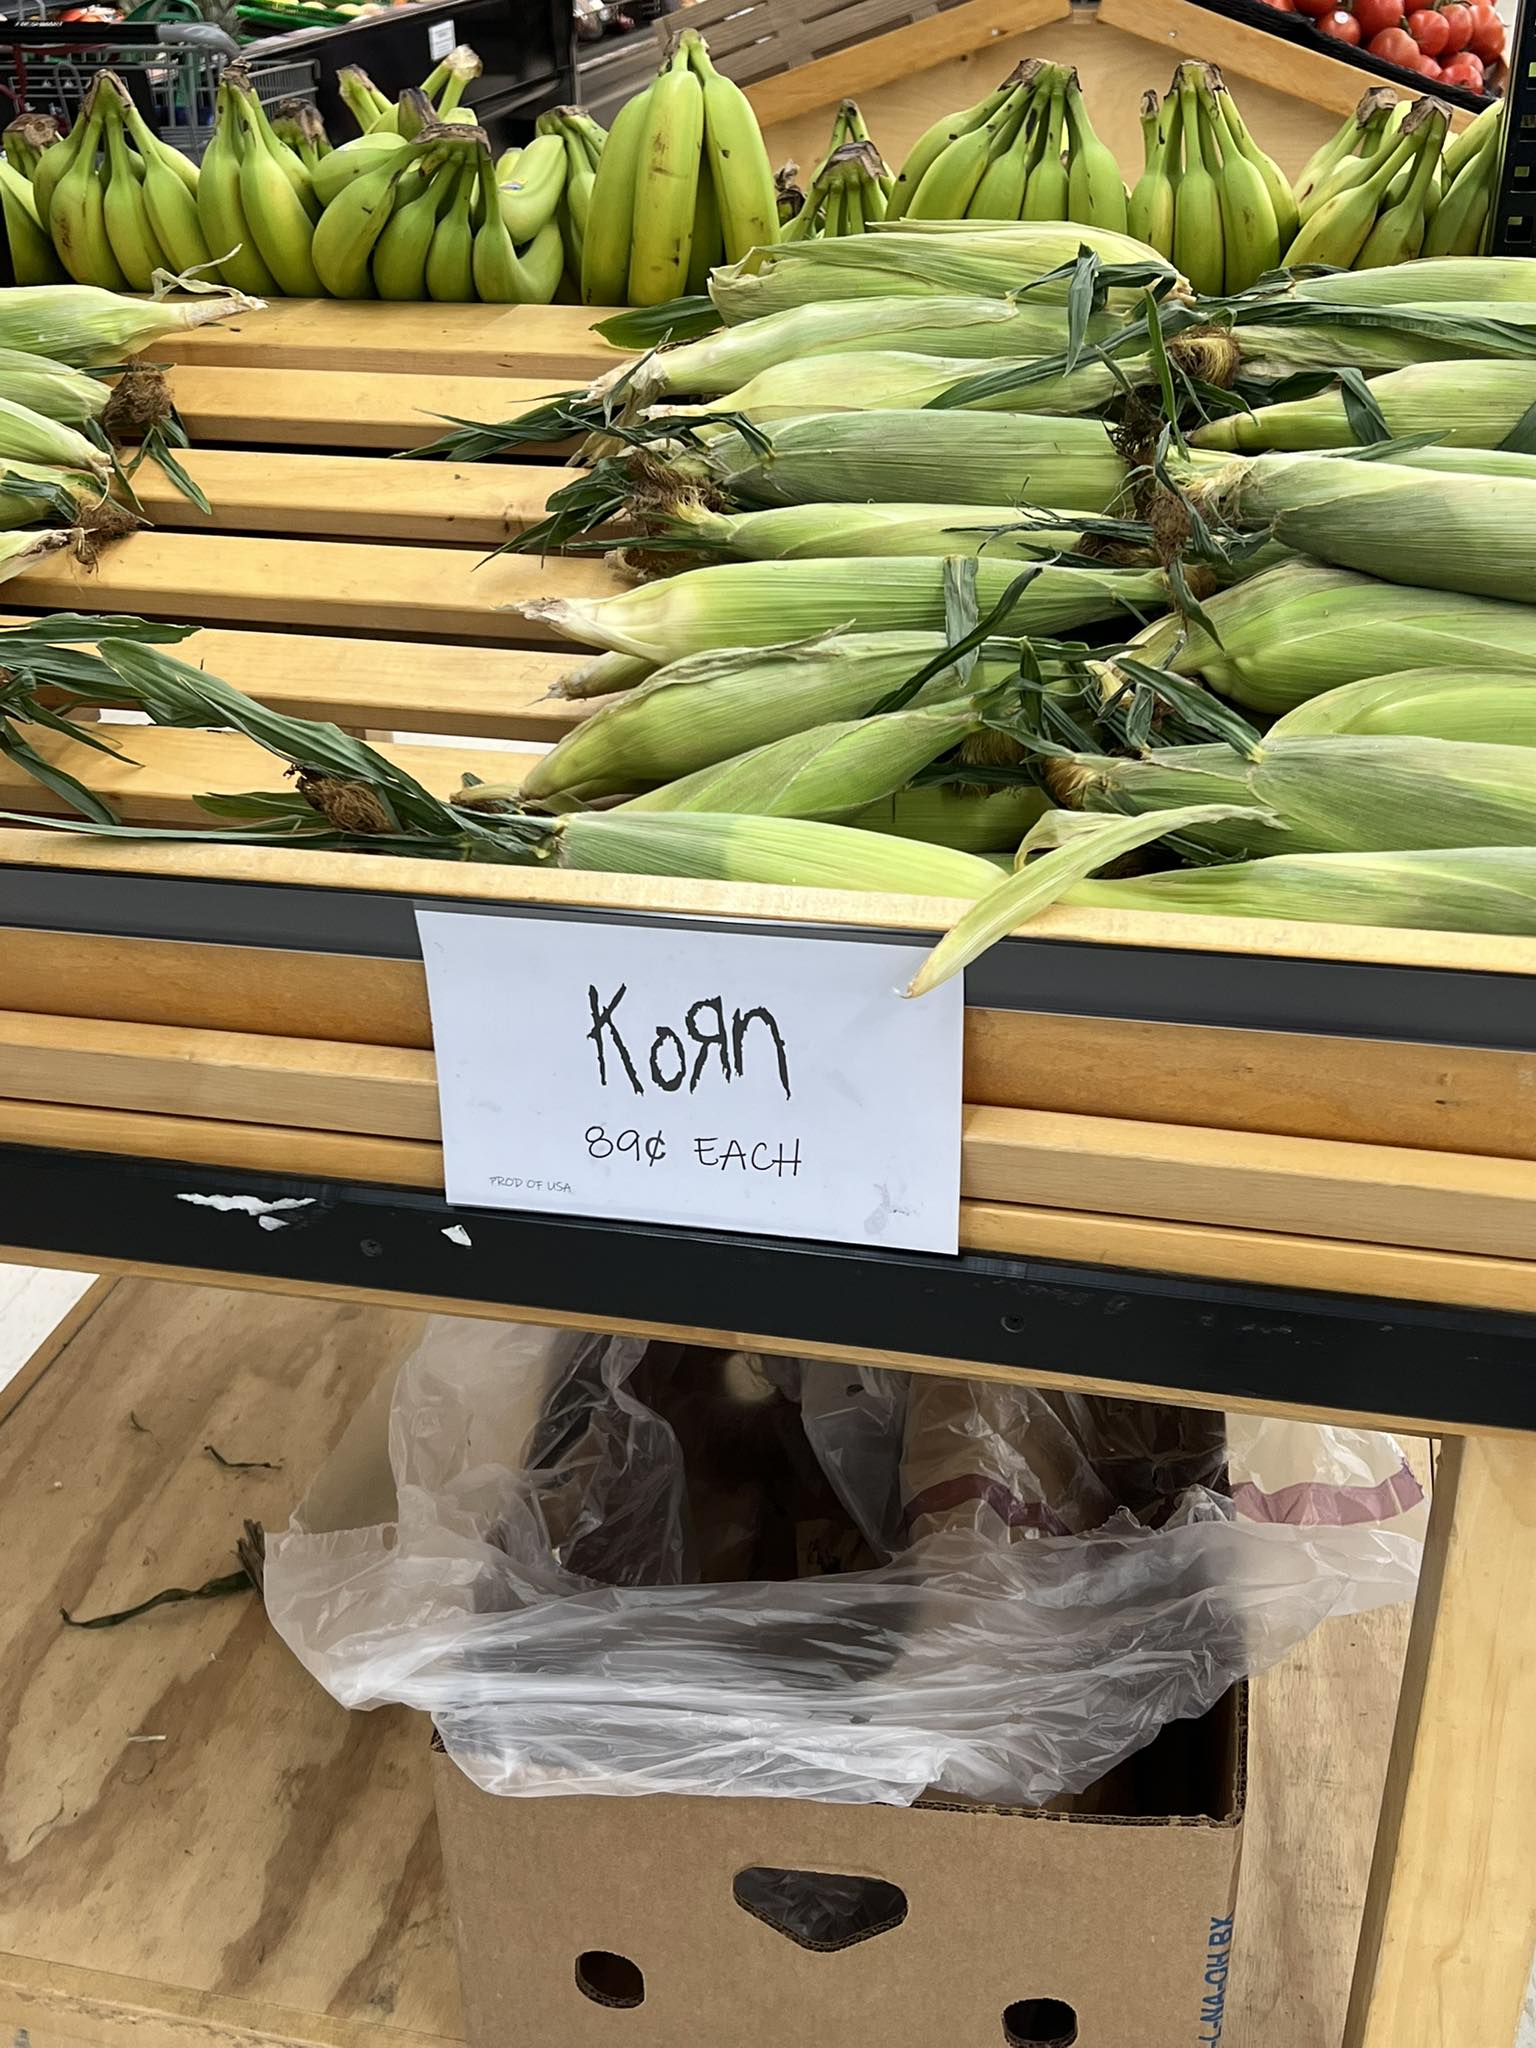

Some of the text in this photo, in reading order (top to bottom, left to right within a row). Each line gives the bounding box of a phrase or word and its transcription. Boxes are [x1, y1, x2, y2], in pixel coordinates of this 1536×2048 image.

[584, 1126, 803, 1177] 89¢ EACH
[489, 1175, 572, 1193] PROD OF USA
